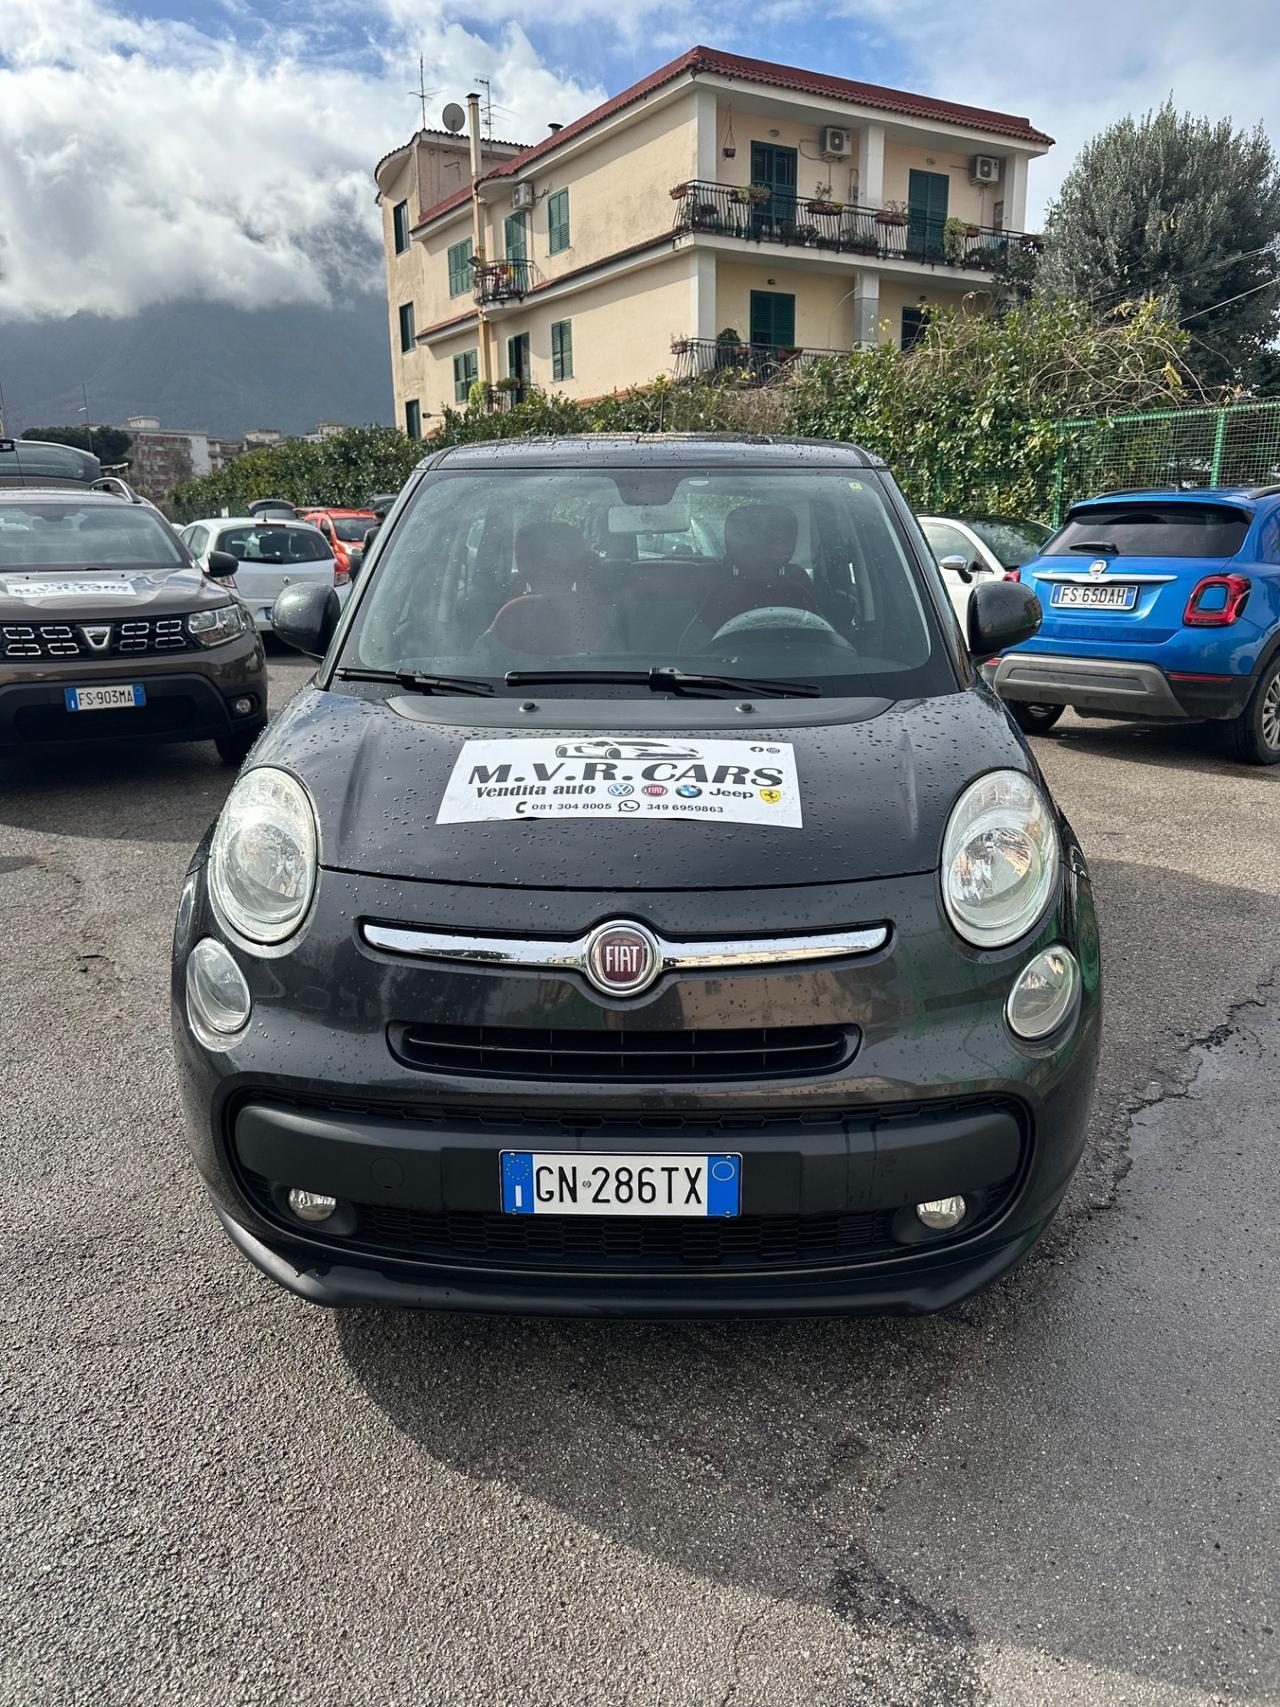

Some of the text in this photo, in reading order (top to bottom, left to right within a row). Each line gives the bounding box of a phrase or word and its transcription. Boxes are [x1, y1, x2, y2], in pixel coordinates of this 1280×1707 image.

[476, 784, 596, 798] Vendita auto
[709, 788, 754, 800] Jeep
[646, 803, 724, 813] 349 6959863
[605, 945, 640, 972] FIAT
